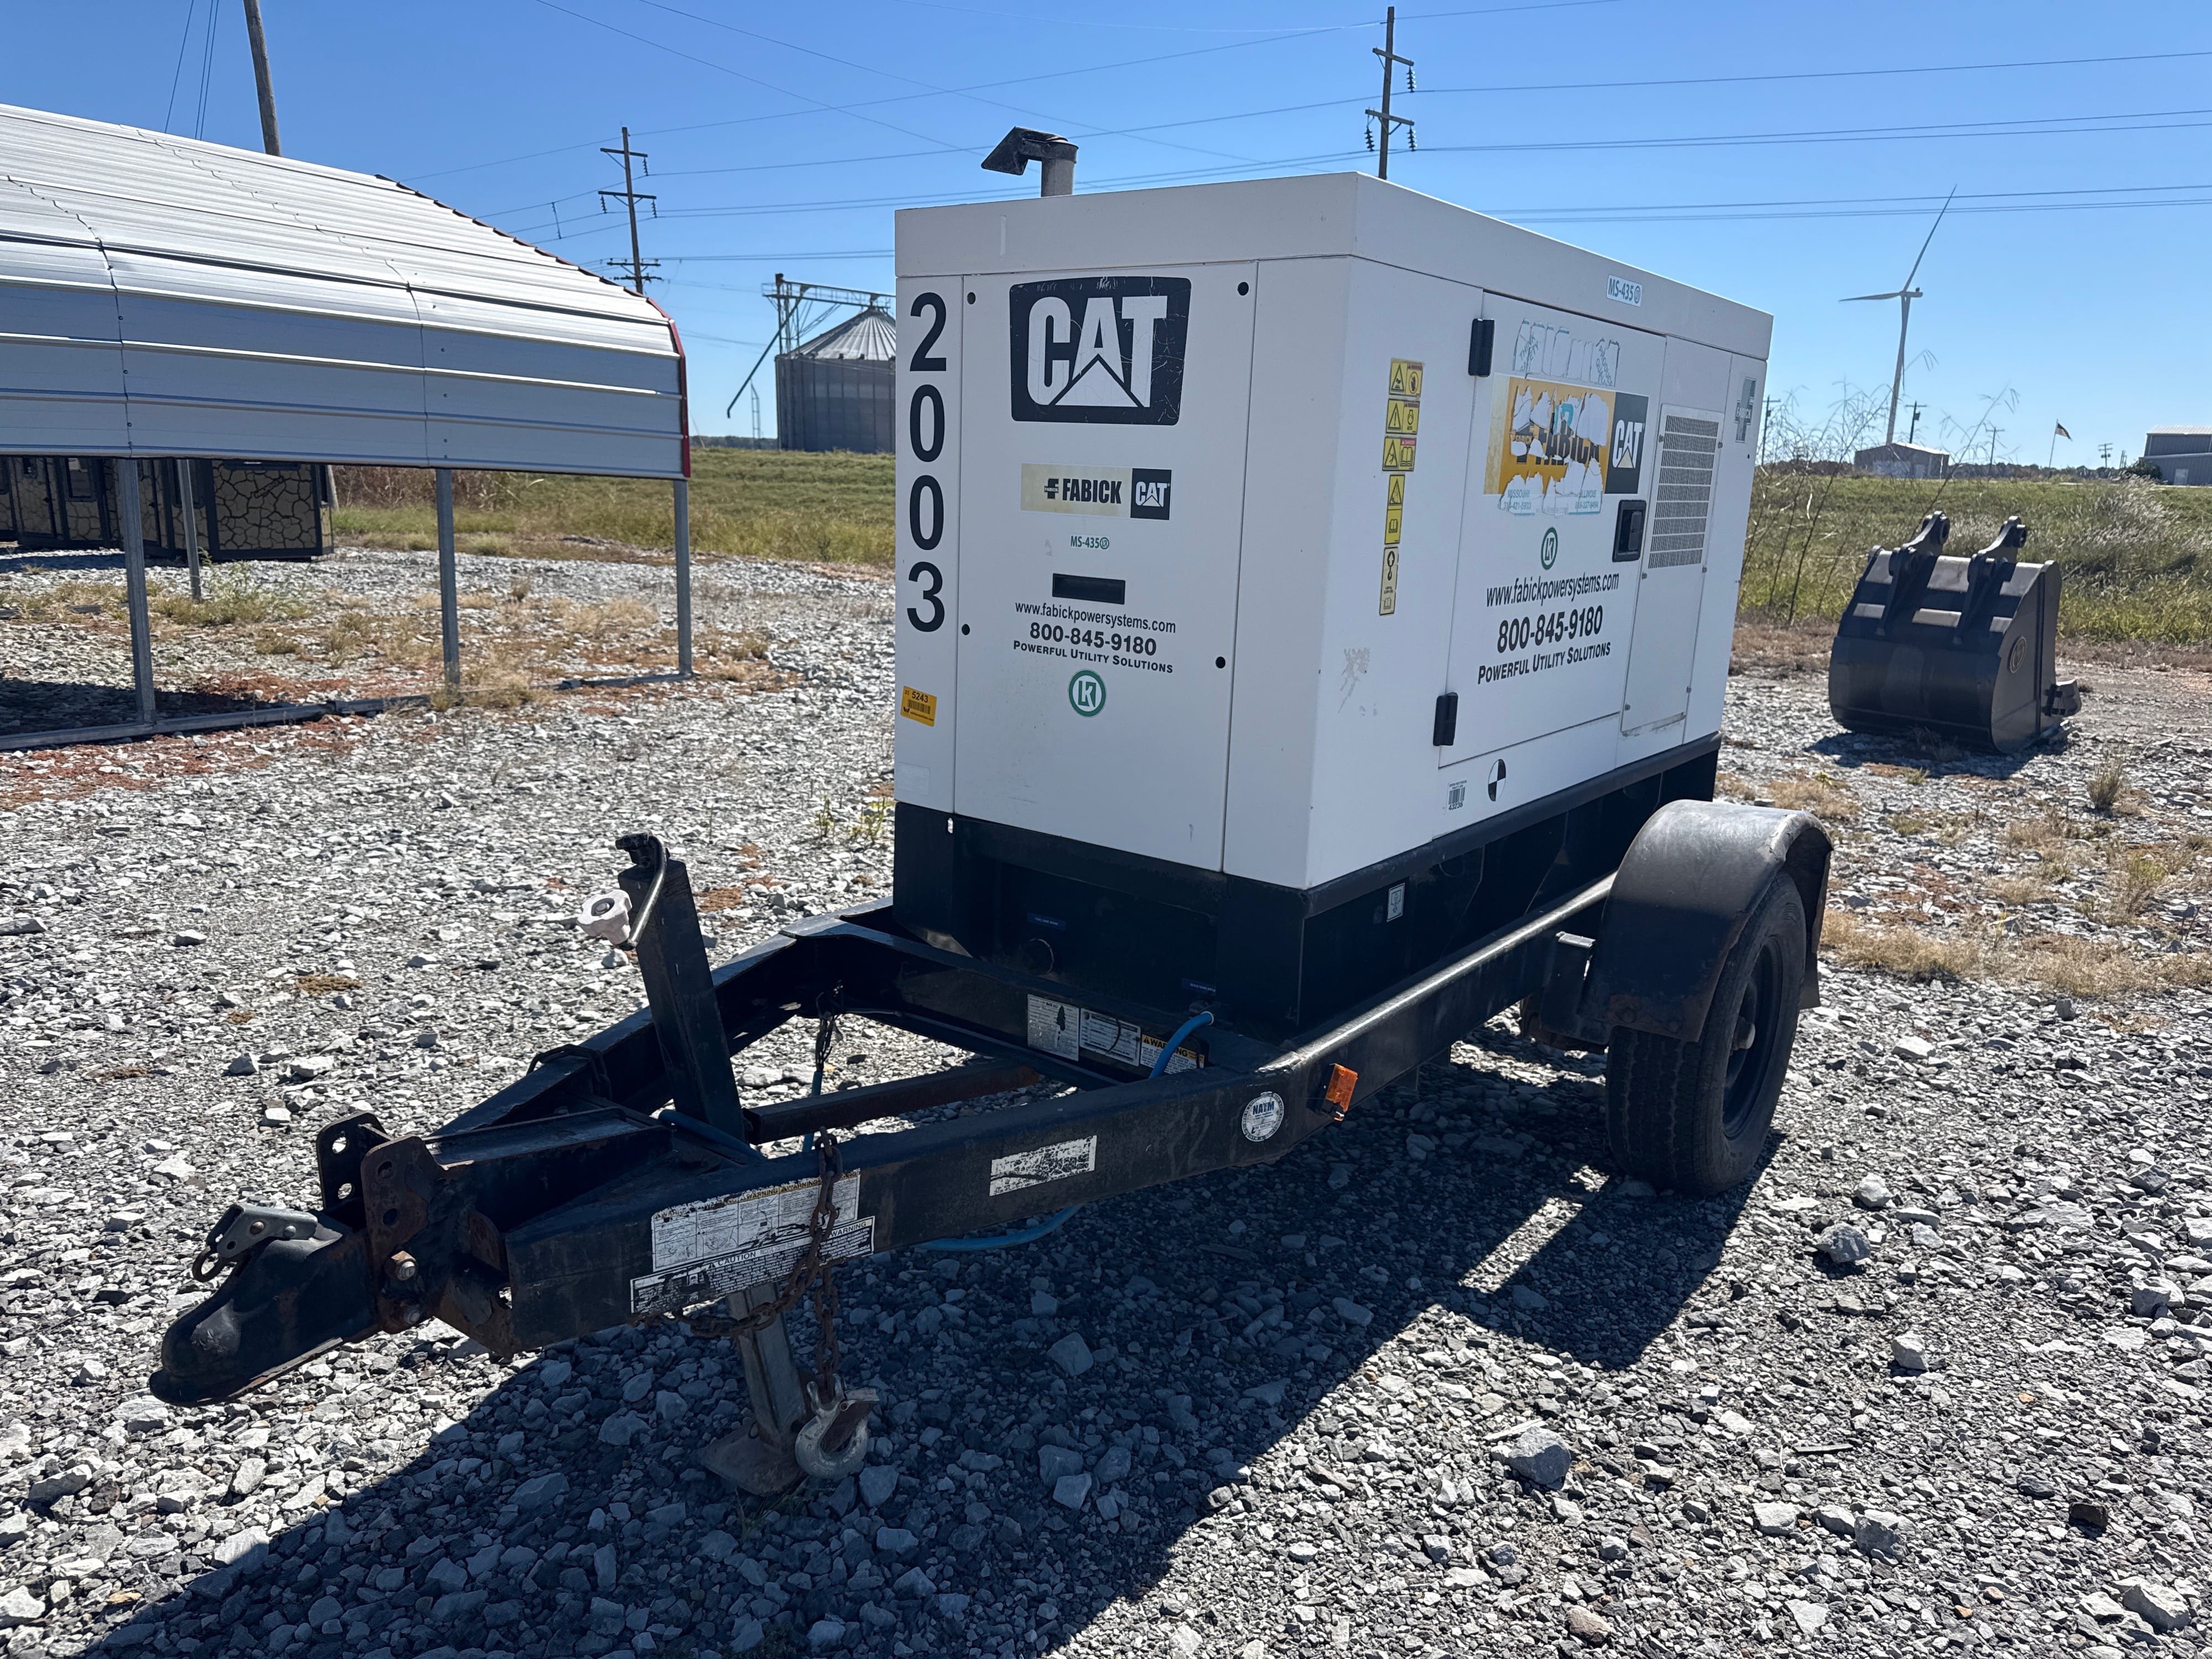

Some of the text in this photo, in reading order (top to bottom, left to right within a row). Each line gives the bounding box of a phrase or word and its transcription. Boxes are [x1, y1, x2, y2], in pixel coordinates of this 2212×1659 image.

[1608, 278, 1634, 302] MS-435
[1027, 296, 1167, 407] CAT
[1613, 420, 1643, 469] CAT
[907, 292, 947, 632] 2003
[1062, 478, 1167, 507] FABICK CAT
[1071, 535, 1099, 548] MS-435
[1487, 572, 1619, 607] www.fabickpowersystems.com
[1015, 601, 1176, 633] www.fabickpowersystems.com
[1497, 606, 1603, 653] 800-845-9180
[1030, 622, 1156, 655] 800-845-9180
[1014, 640, 1173, 673] POWERFUL UTILITY SOLUTIONS
[1478, 642, 1610, 684] POWERFUL UTILITY SOLUTIONS
[911, 691, 928, 703] 5243
[1150, 1036, 1188, 1057] WARNG
[1253, 1101, 1275, 1115] NATM
[745, 1187, 779, 1200] WARNING
[786, 1179, 820, 1192] WARNING
[831, 1221, 867, 1237] WARNING
[718, 1251, 757, 1266] CAUTION
